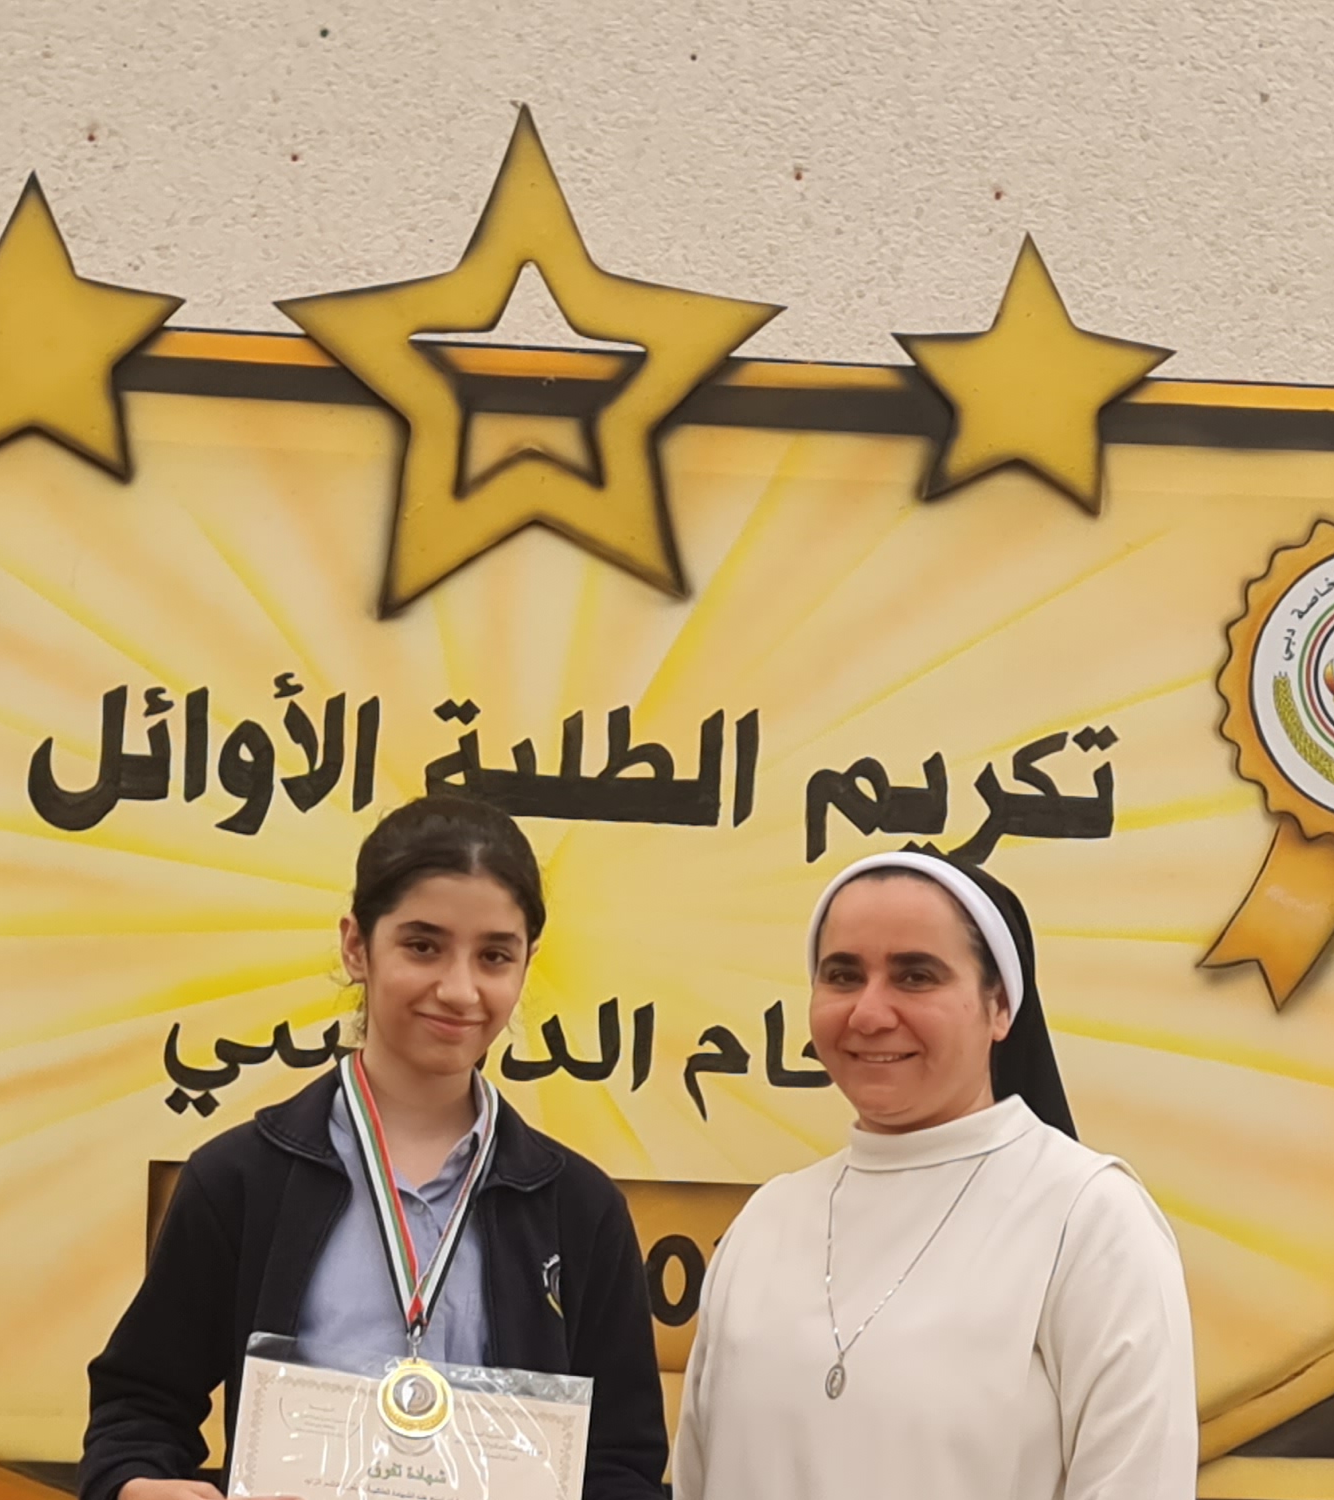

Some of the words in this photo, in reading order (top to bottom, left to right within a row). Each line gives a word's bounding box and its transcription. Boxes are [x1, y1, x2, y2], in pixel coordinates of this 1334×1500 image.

[1282, 628, 1296, 661] دبي
[28, 672, 379, 835] الأوائل
[426, 699, 758, 827] الطلبة
[806, 725, 1119, 866] تكريم
